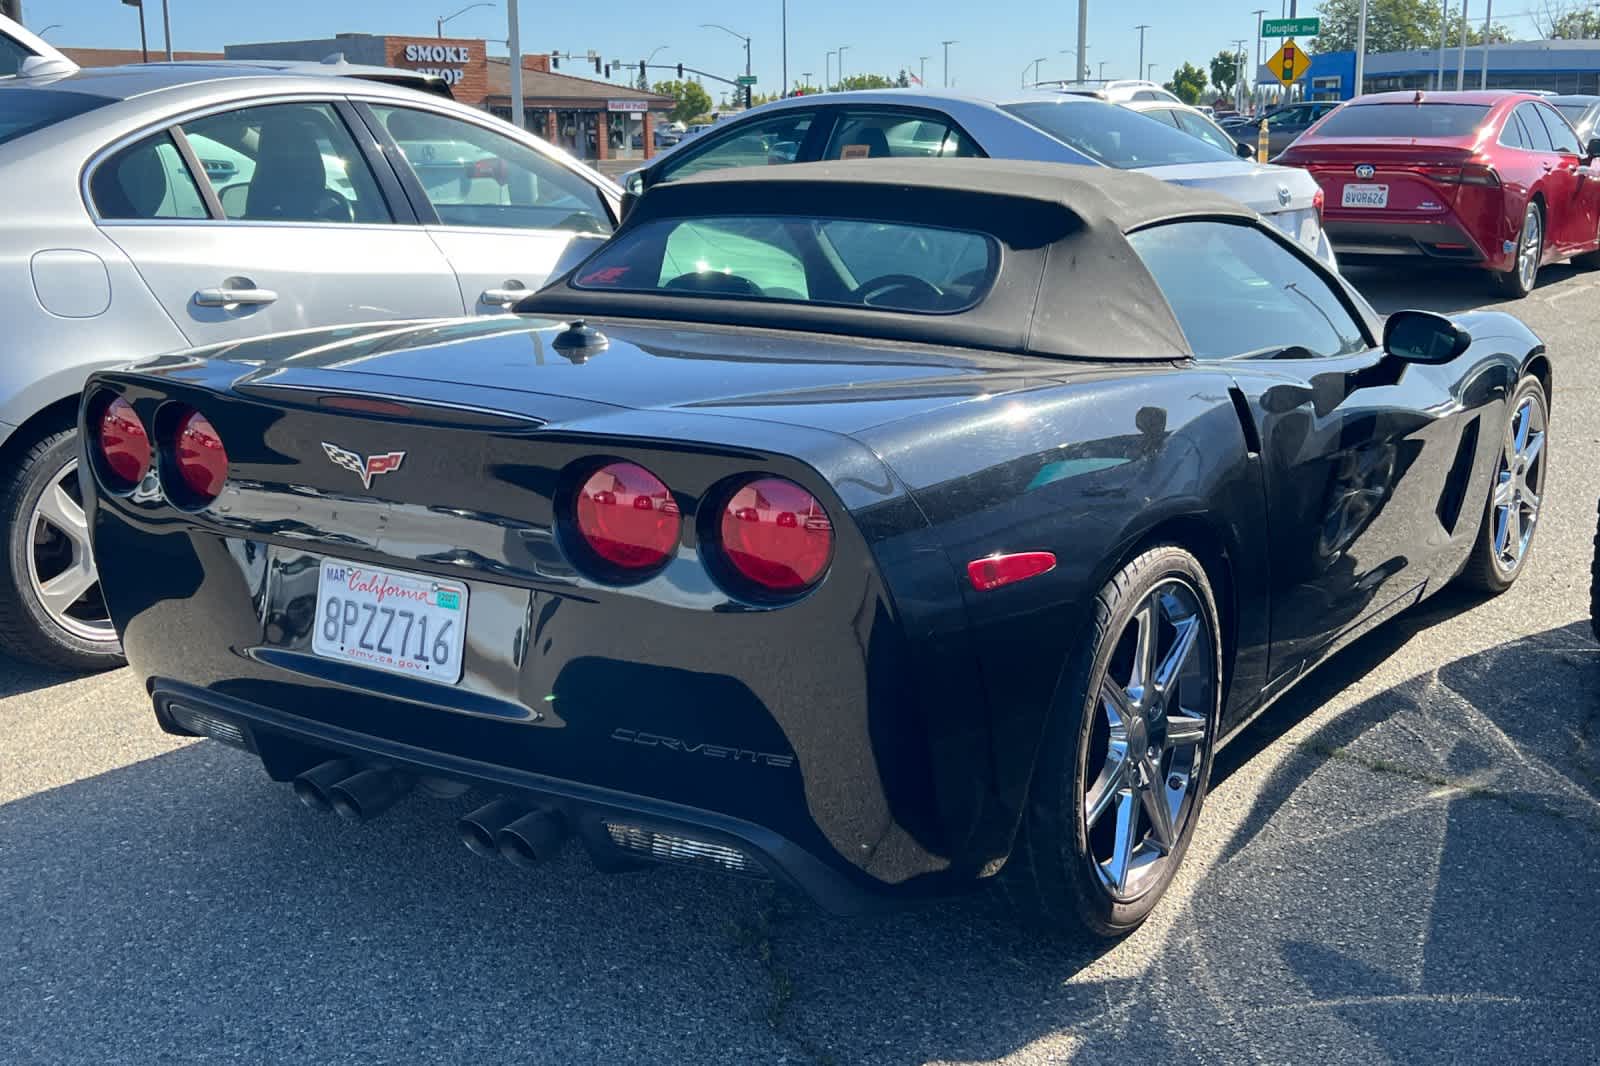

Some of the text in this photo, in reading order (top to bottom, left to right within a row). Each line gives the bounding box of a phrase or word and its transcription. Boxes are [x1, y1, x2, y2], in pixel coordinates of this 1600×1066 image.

[1265, 23, 1298, 34] Douglas
[406, 44, 470, 63] SMOKE
[416, 67, 464, 84] HOP
[326, 567, 346, 582] MAR
[348, 570, 434, 603] California
[323, 596, 453, 665] 8PZZ716
[347, 647, 423, 670] dmv.ca.gov
[611, 727, 794, 767] CORVETTE
